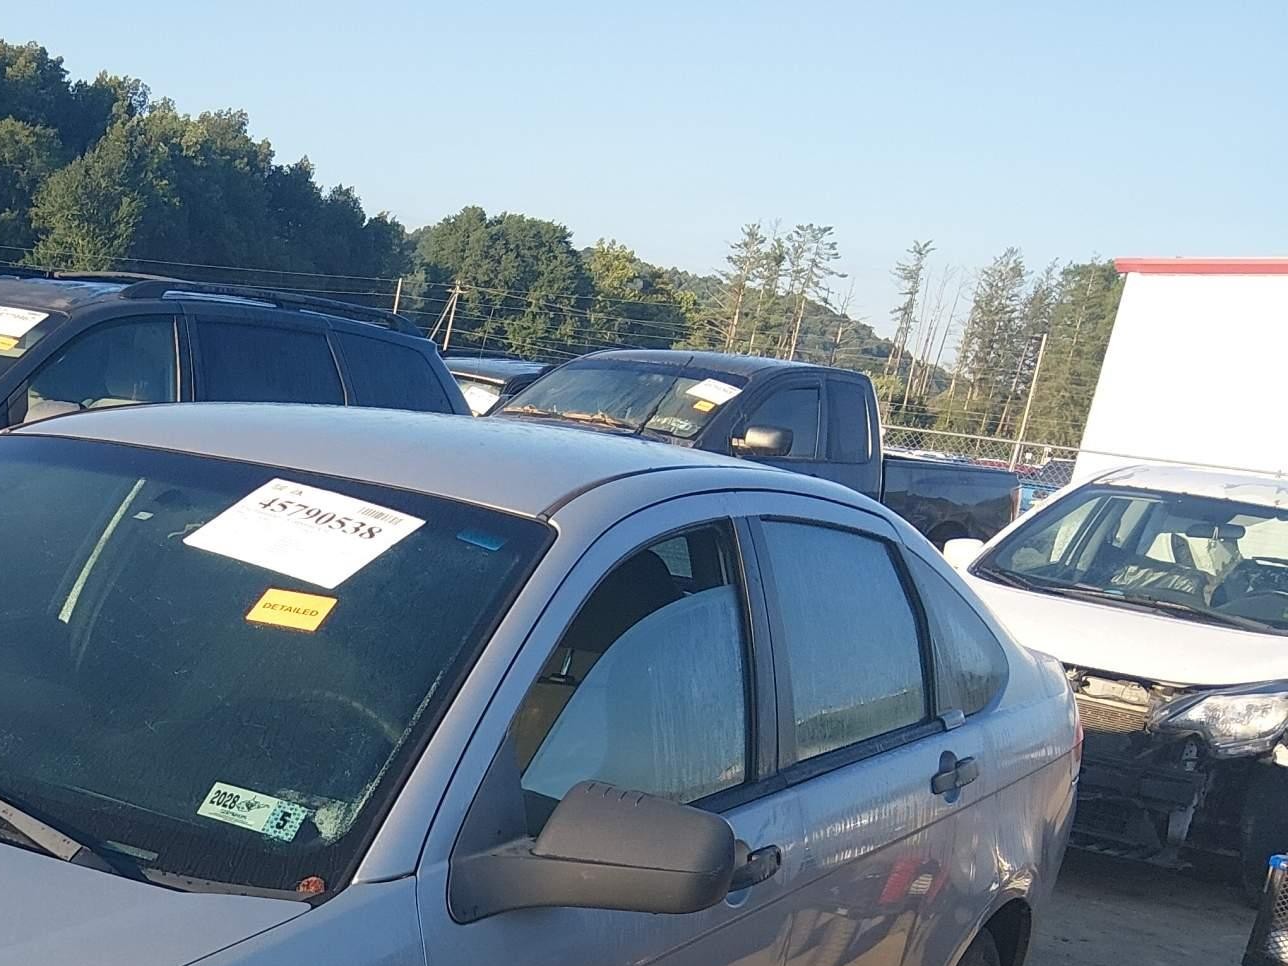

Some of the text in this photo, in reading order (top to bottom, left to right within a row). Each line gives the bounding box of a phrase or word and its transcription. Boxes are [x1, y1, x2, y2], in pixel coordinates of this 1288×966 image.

[258, 496, 384, 541] 45790538
[262, 600, 320, 618] DETAILED
[209, 789, 241, 810] 2028
[275, 810, 292, 830] 5
